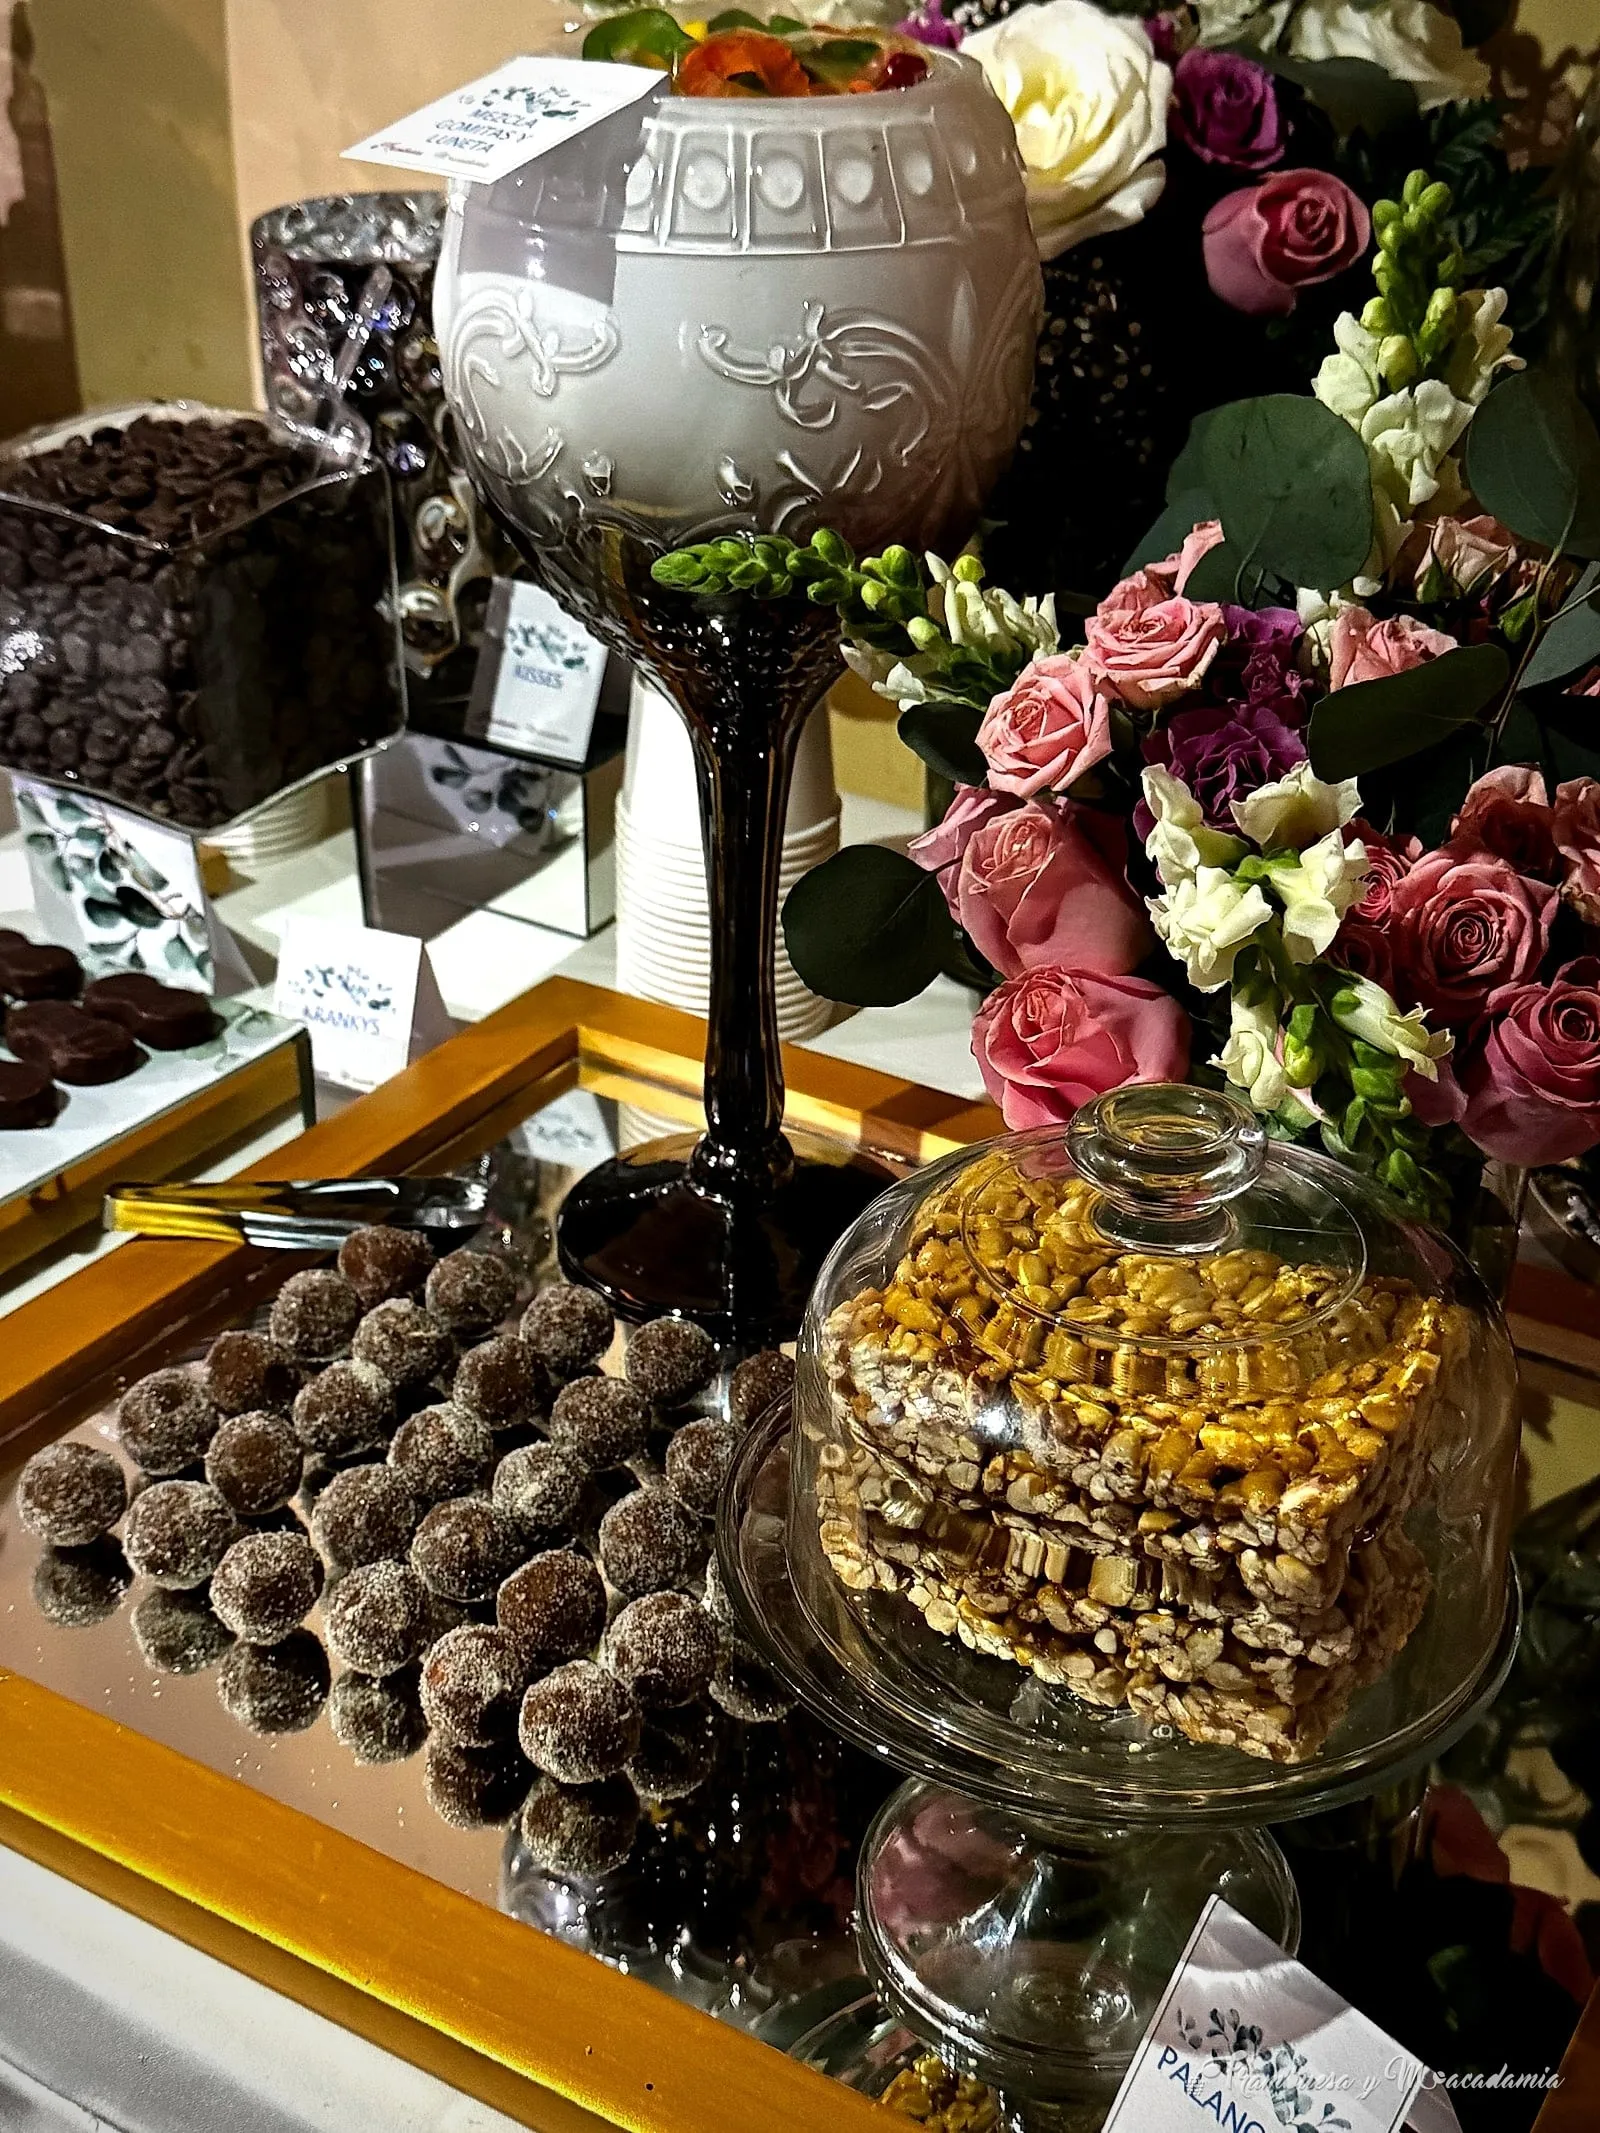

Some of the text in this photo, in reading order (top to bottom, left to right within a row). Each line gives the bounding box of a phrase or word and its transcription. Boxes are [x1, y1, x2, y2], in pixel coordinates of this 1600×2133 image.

[468, 108, 538, 129] MEZCLA
[435, 119, 516, 141] GOMITAS
[425, 134, 495, 153] LUNETA
[302, 1005, 380, 1036] KRANKYS
